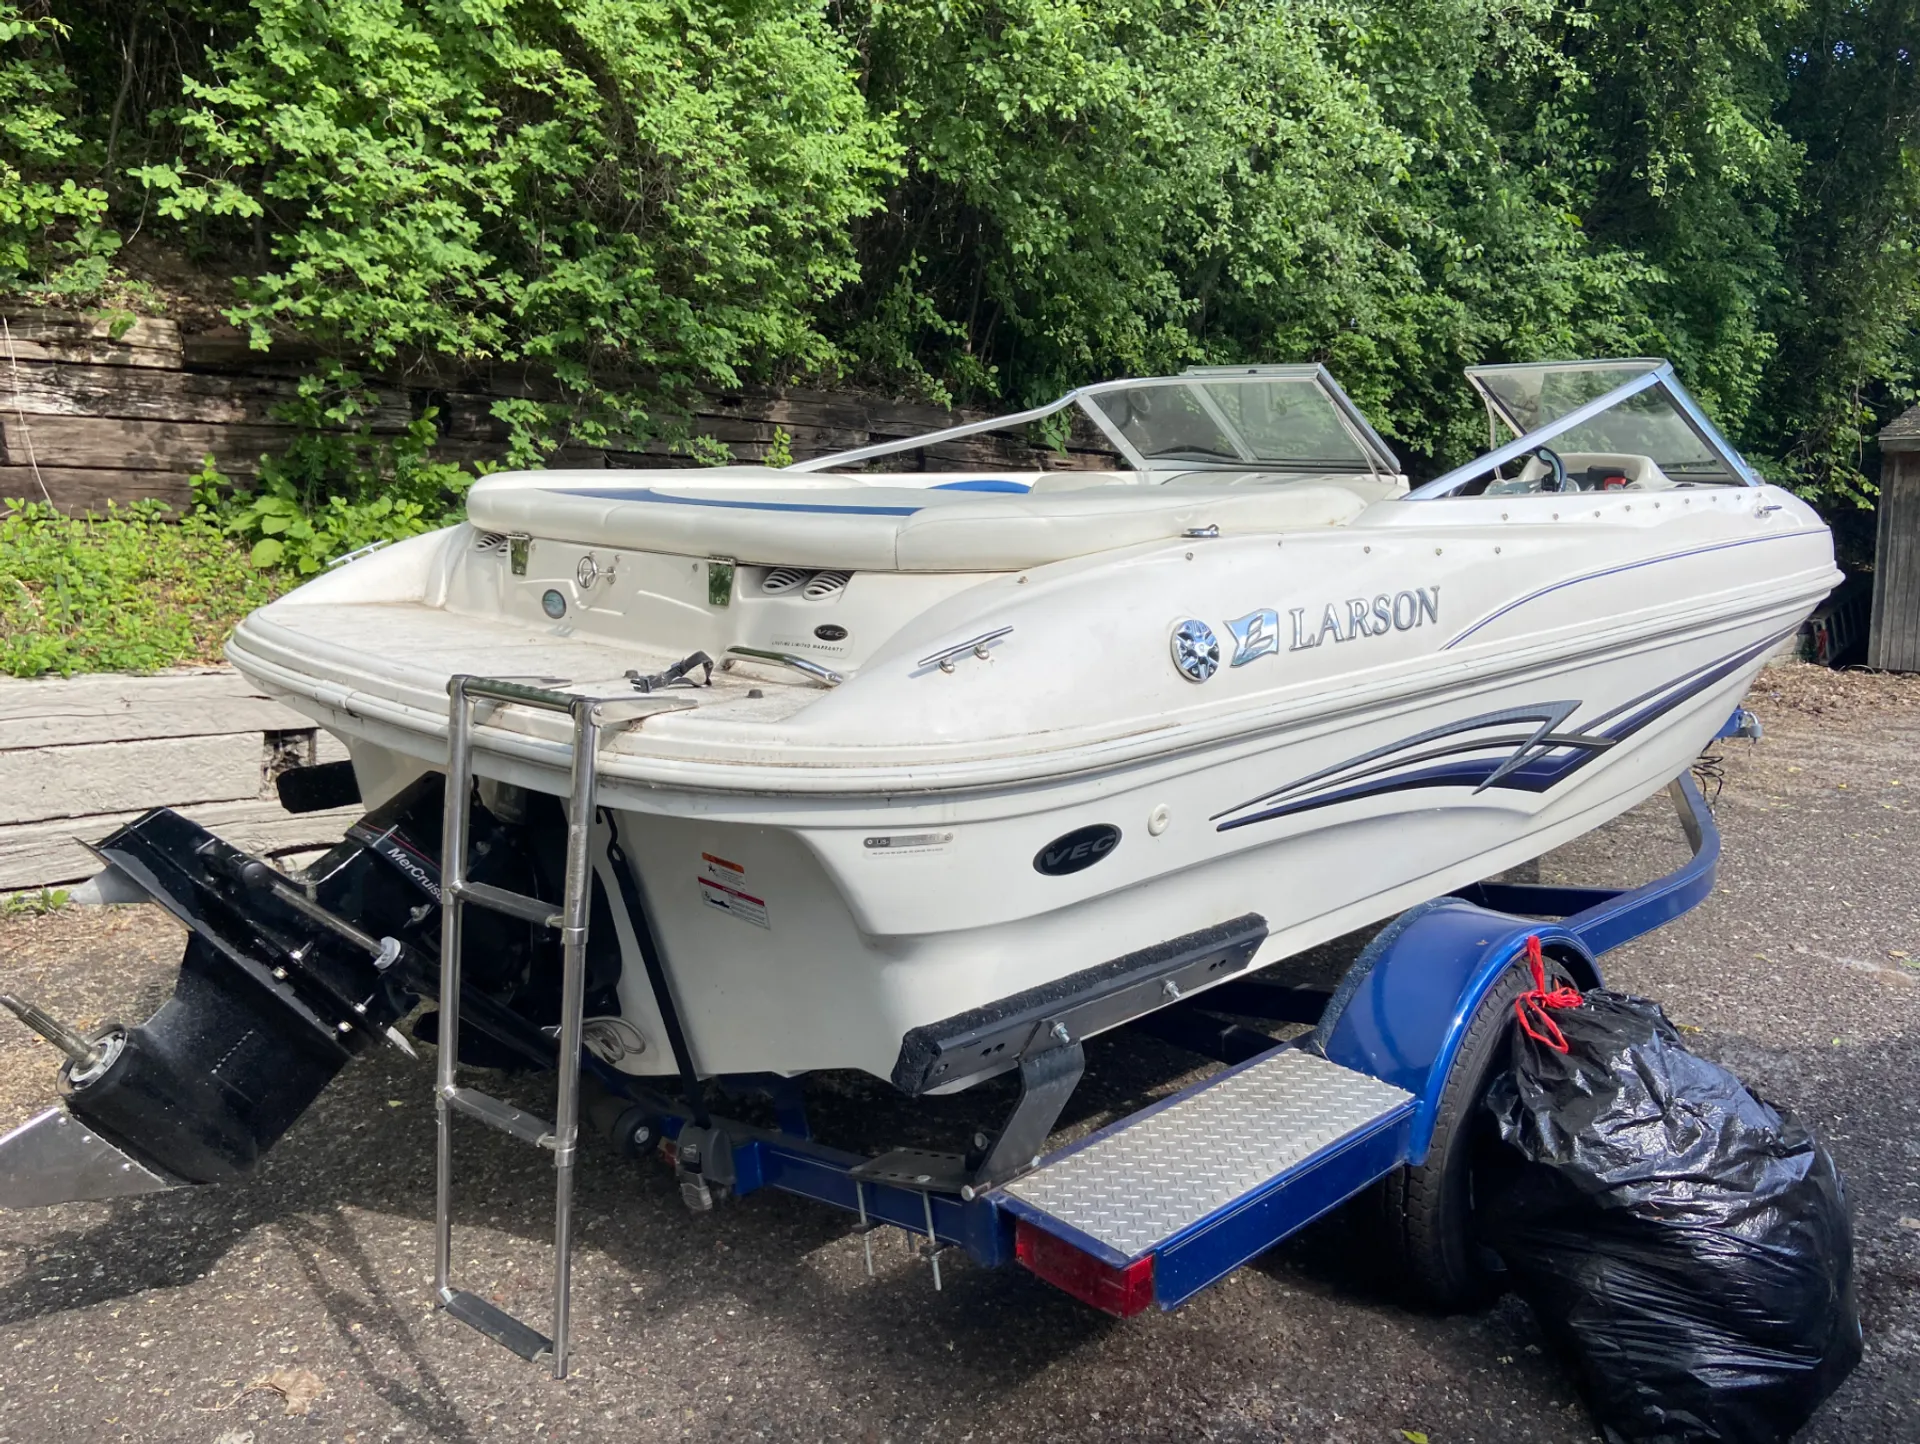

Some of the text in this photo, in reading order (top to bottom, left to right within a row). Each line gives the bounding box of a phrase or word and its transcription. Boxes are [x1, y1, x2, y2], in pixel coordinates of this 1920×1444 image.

[1289, 585, 1440, 652] LARSON
[817, 629, 845, 637] VEC
[812, 644, 844, 652] WARRANTY
[1045, 832, 1117, 867] VEC
